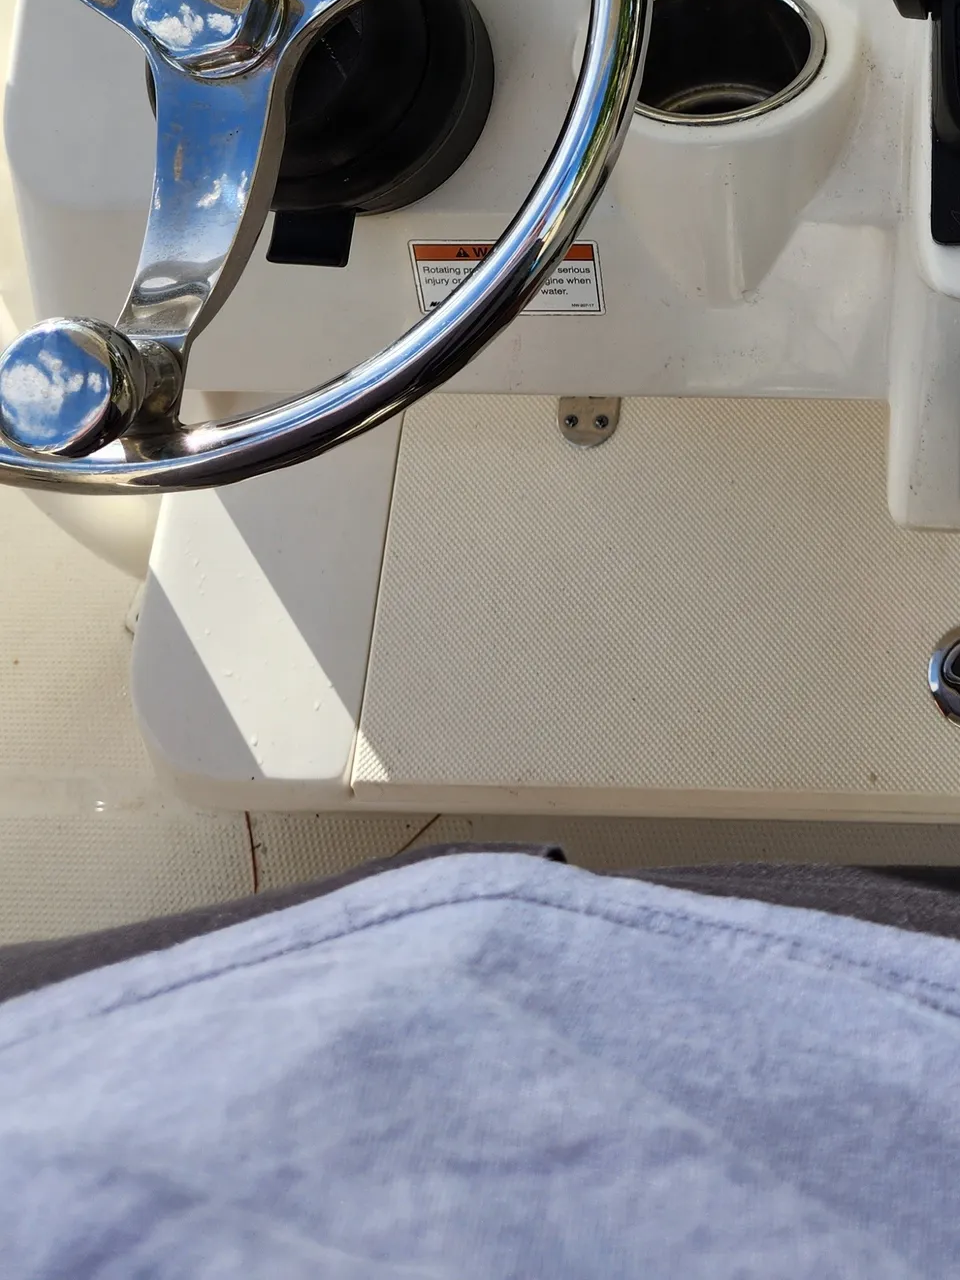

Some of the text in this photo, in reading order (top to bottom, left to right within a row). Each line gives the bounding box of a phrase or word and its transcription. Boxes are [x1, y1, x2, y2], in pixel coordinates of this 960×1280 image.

[422, 266, 461, 275] Rotating
[557, 266, 591, 274] serious
[425, 277, 450, 286] injury
[566, 277, 592, 285] when
[541, 288, 569, 296] water.
